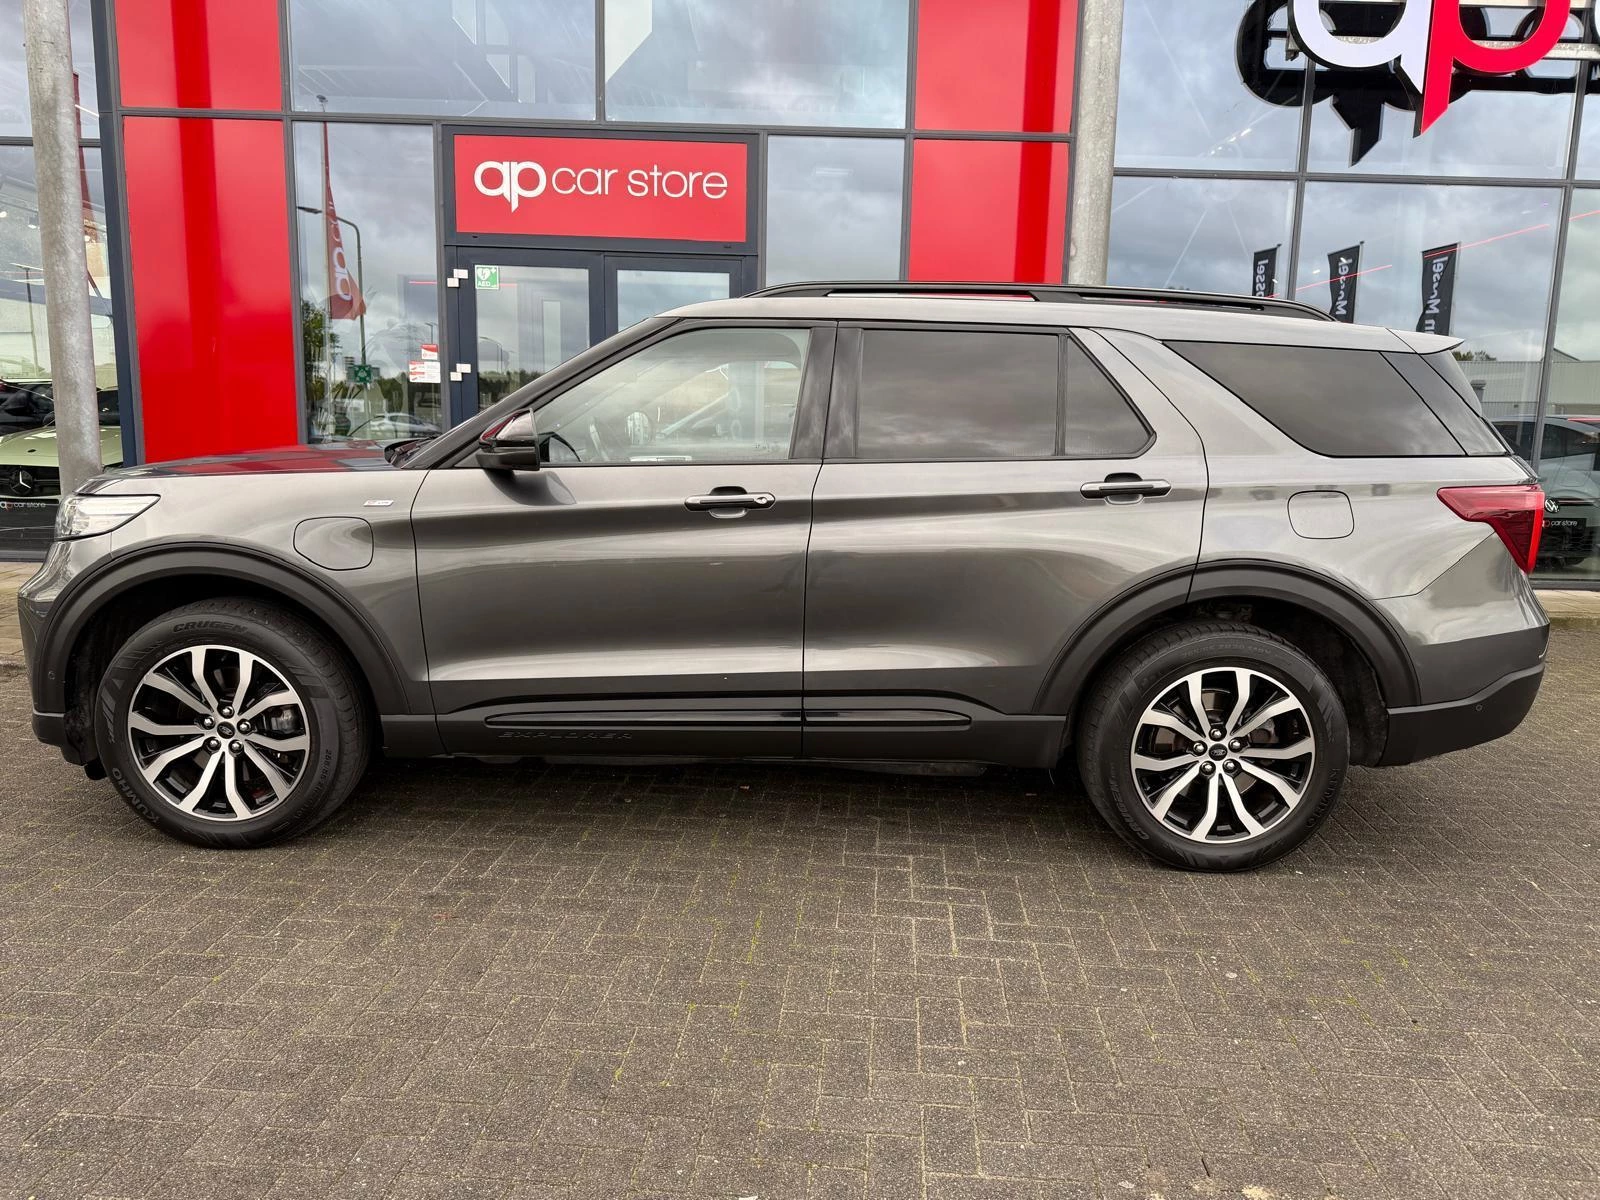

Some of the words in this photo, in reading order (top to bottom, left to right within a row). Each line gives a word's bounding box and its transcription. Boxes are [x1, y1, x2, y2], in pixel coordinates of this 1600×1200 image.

[552, 167, 618, 195] car
[627, 164, 728, 199] store
[173, 620, 248, 633] CRUGEN
[497, 731, 633, 740] EXPLORER
[112, 767, 160, 823] KUMHO
